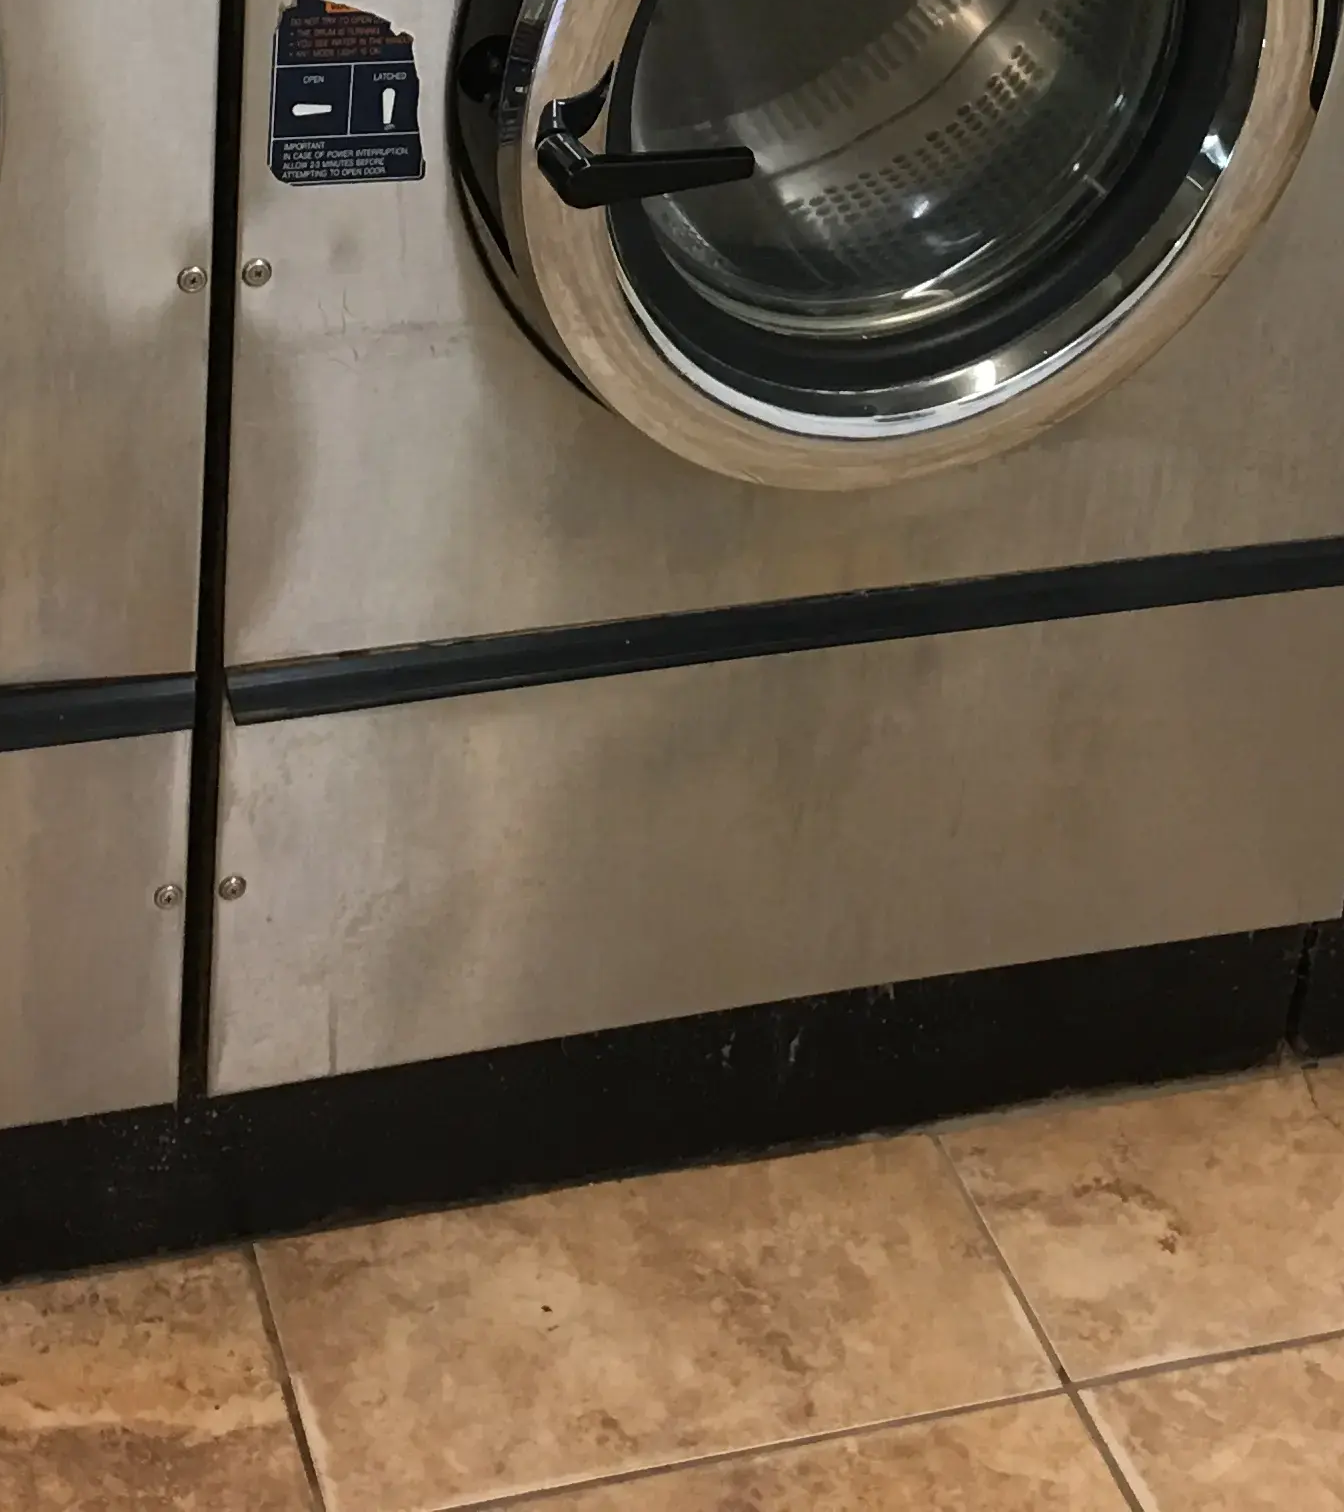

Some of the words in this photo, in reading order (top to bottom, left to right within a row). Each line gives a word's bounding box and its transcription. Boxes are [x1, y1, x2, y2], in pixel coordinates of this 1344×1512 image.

[303, 75, 325, 84] OPEN
[373, 72, 407, 81] LATCHED
[284, 142, 325, 150] IMPORTANT
[293, 151, 312, 160] CASE
[314, 151, 325, 159] OF
[327, 149, 353, 158] POWER
[282, 161, 308, 169] ALLOW
[322, 159, 354, 168] MINUTES
[356, 158, 384, 166] BEFORE
[282, 169, 327, 178] ATTEMPTING
[341, 167, 362, 176] OPEN
